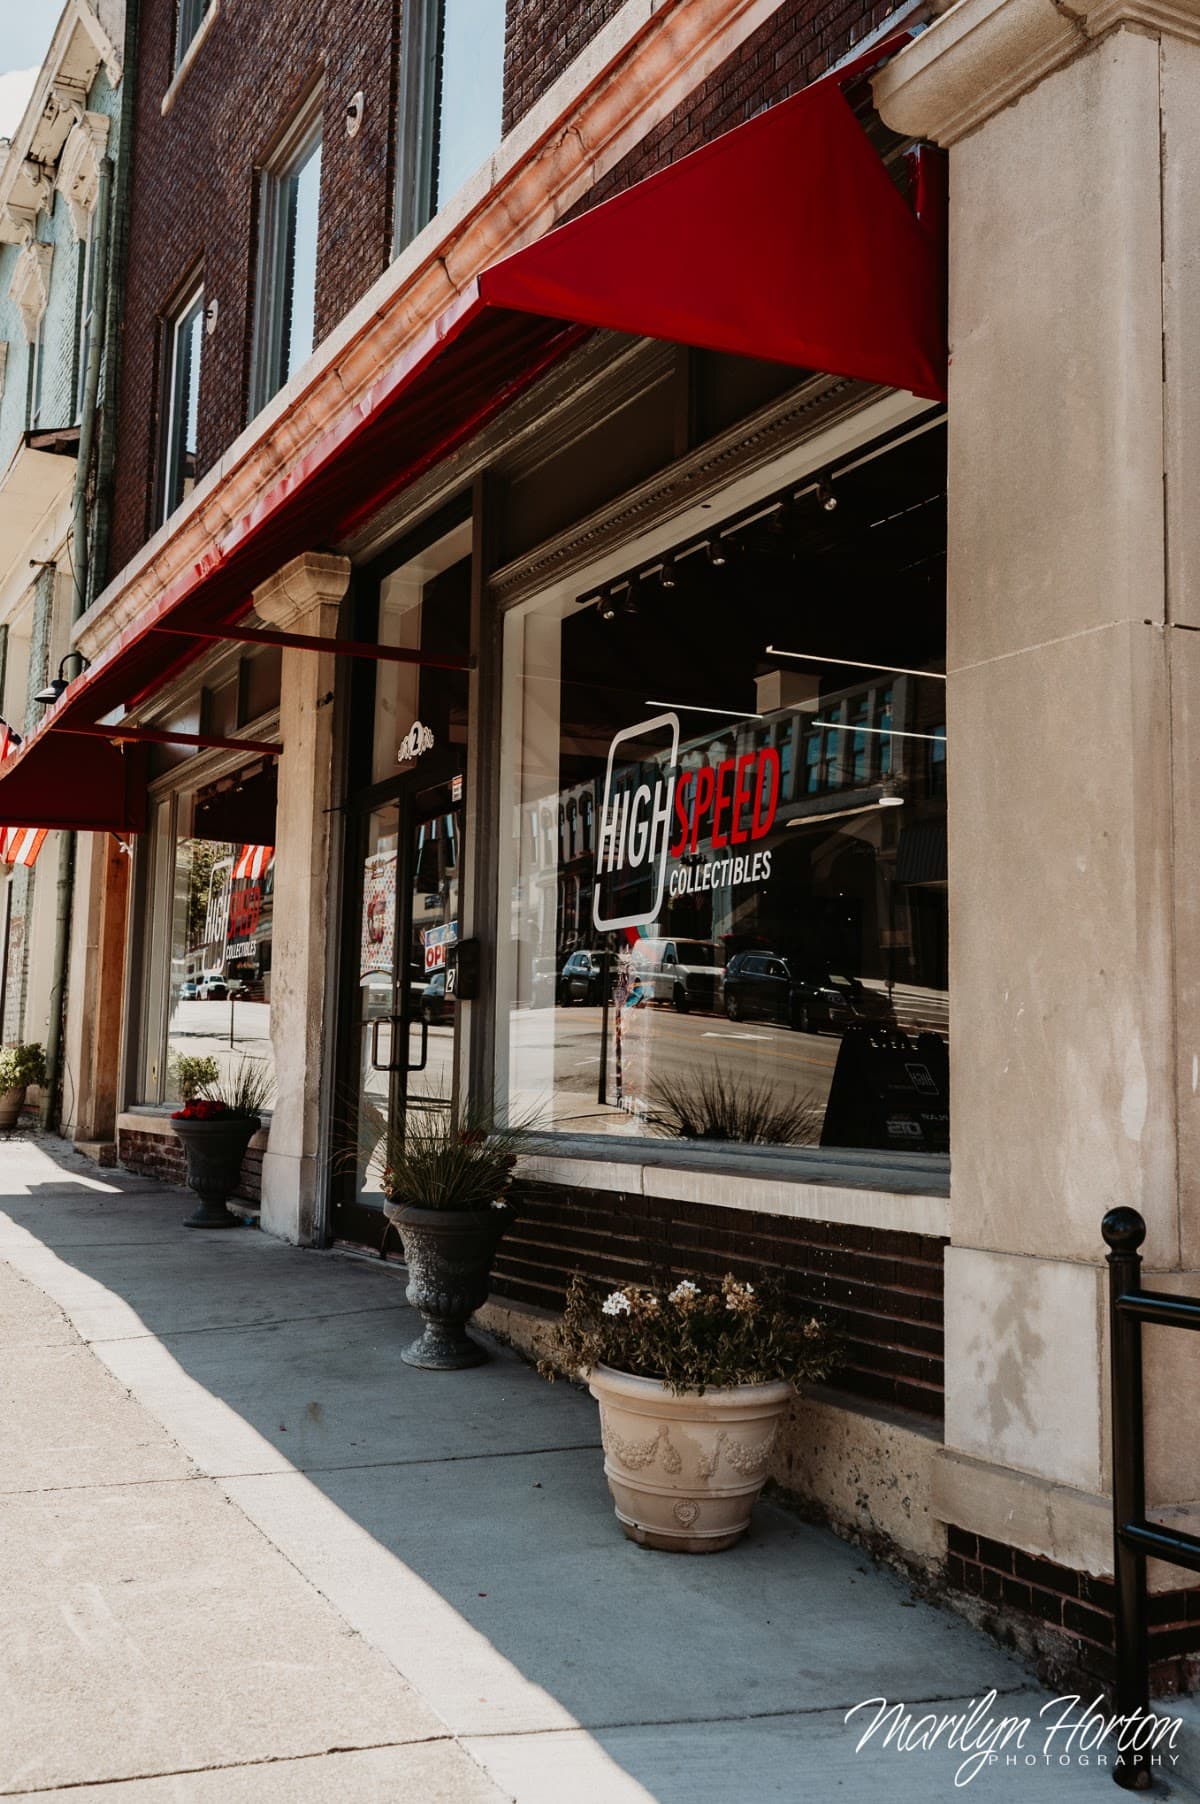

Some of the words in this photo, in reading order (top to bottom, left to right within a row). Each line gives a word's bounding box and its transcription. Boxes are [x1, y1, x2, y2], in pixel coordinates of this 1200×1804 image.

[597, 776, 675, 874] HIGH
[671, 747, 780, 858] SPEED
[669, 850, 772, 896] COLLECTIBLES
[204, 895, 232, 944] HIGH
[227, 886, 261, 939] SPEED
[226, 940, 257, 960] COLLECTIBLES
